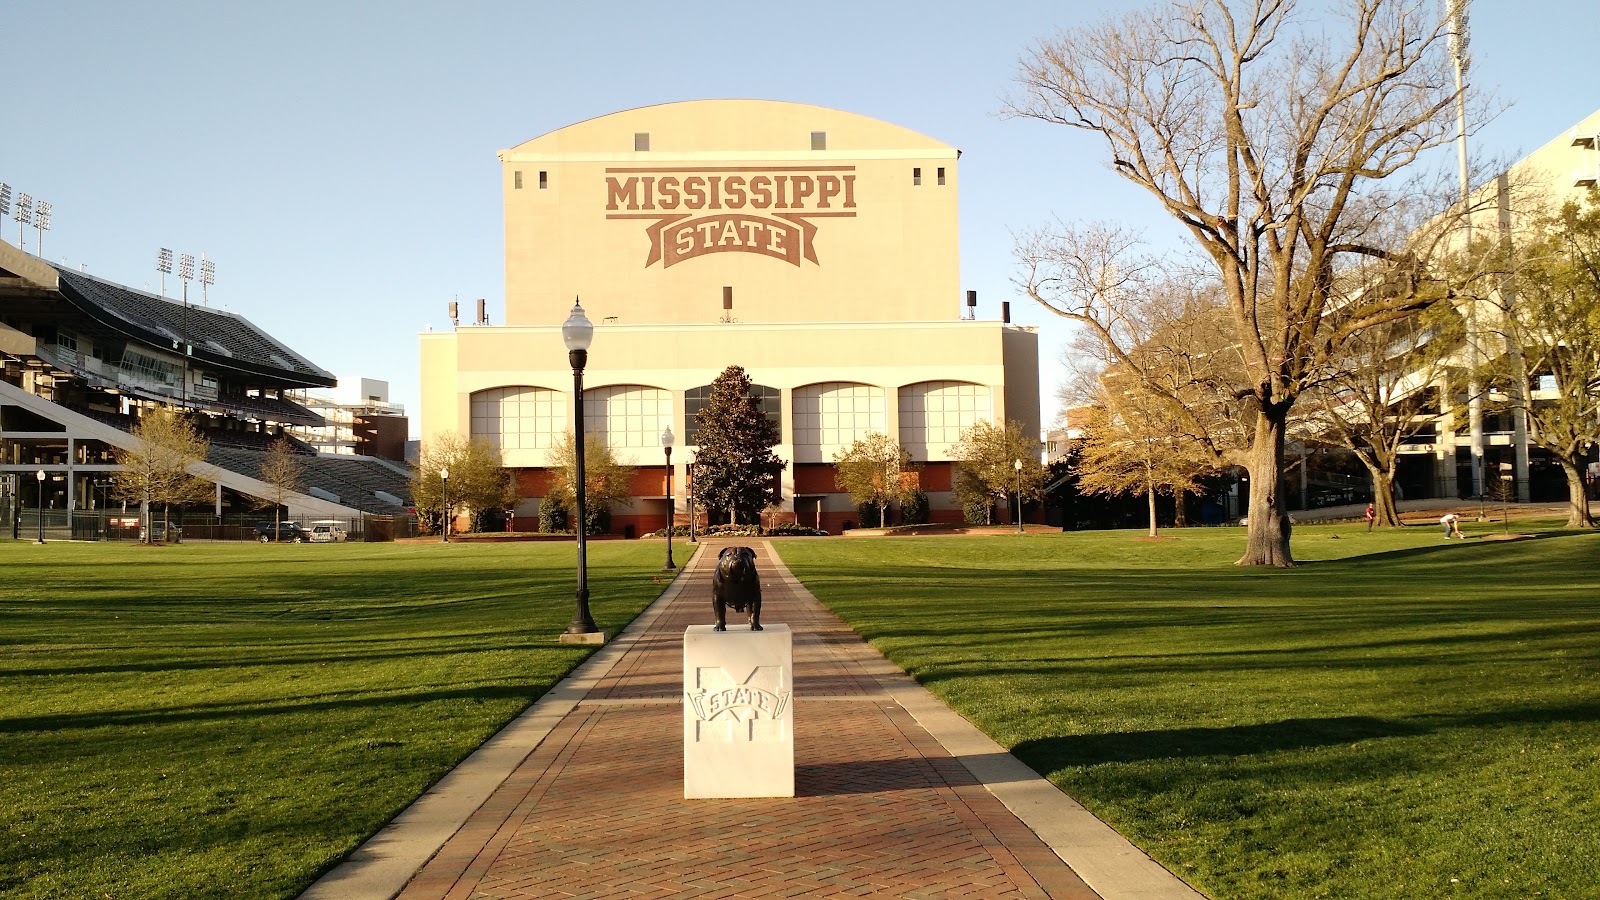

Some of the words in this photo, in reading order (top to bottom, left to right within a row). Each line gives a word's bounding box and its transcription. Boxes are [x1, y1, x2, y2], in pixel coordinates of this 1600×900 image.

[605, 175, 857, 210] MISSISSIPPI
[676, 219, 787, 256] STATE
[709, 687, 770, 713] STATE
